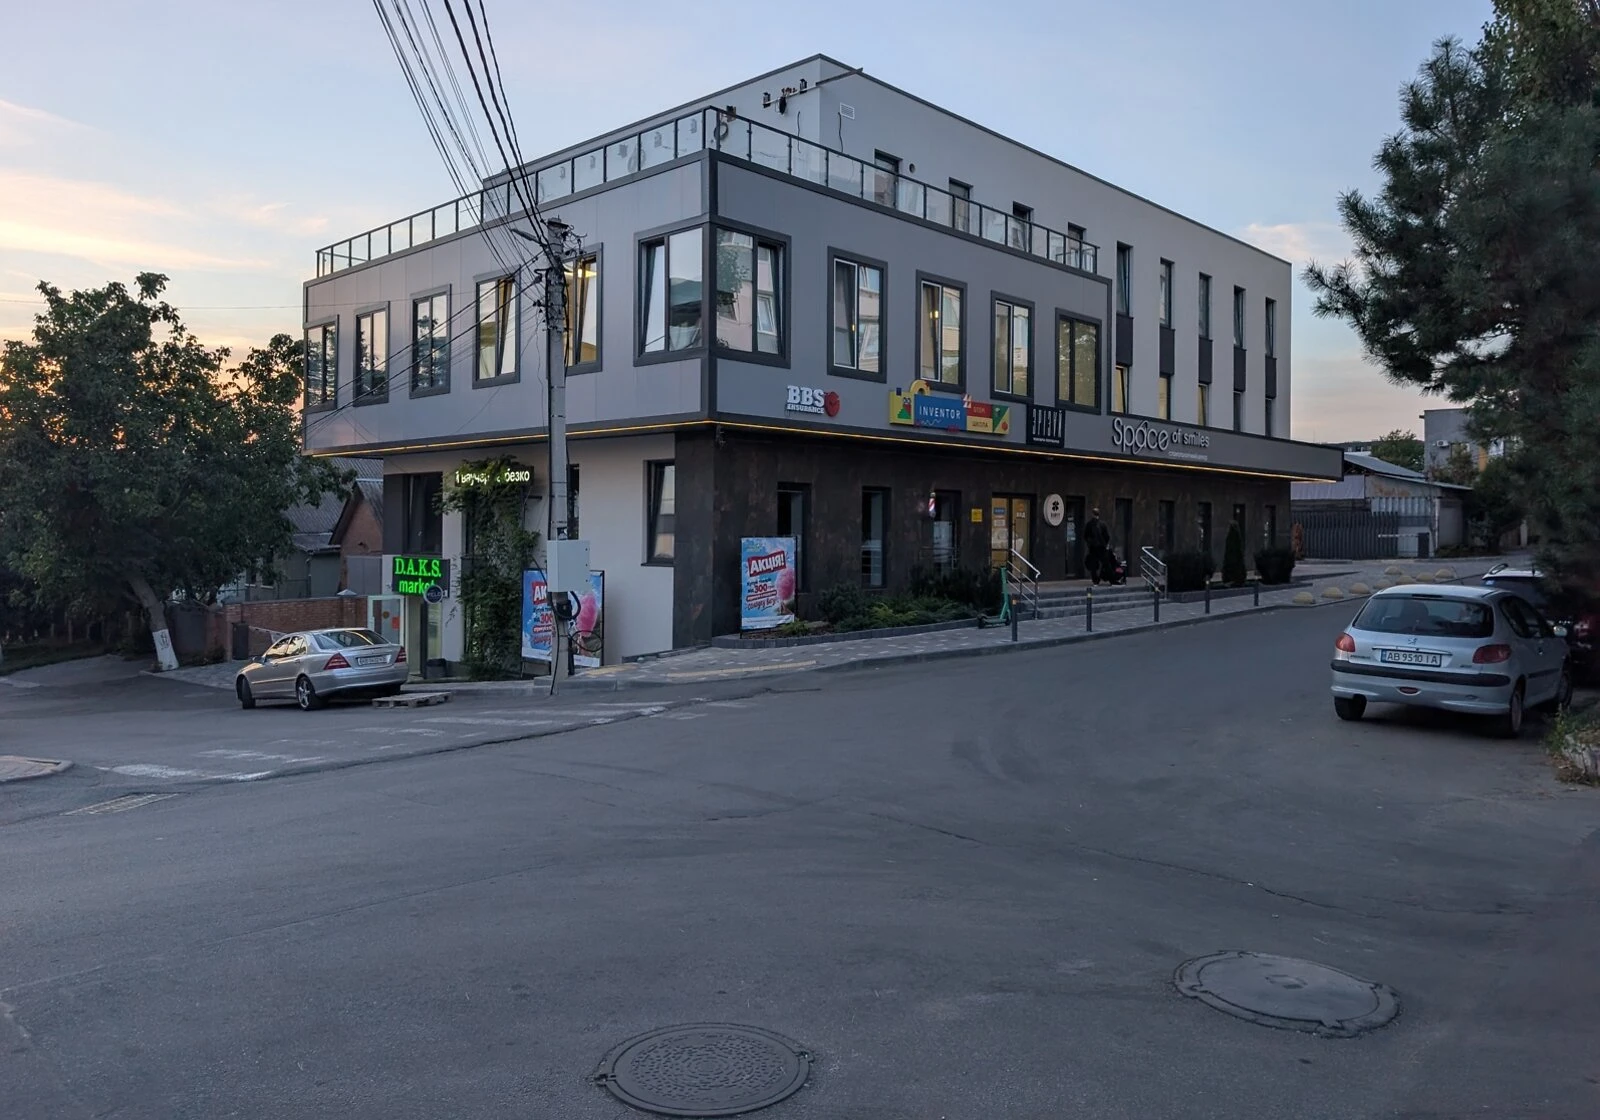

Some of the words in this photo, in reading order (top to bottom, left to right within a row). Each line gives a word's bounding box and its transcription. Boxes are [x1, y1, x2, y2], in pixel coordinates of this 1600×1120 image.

[787, 385, 825, 407] BBS
[919, 405, 961, 419] INVENTOR
[1113, 417, 1169, 455] Space
[1172, 427, 1183, 443] of
[1183, 431, 1210, 448] smiles
[394, 558, 442, 577] D.A.K.S.
[750, 553, 785, 574] АКЦІЯ!
[754, 583, 768, 594] 300
[1387, 652, 1400, 661] AB
[1402, 654, 1422, 663] 9510
